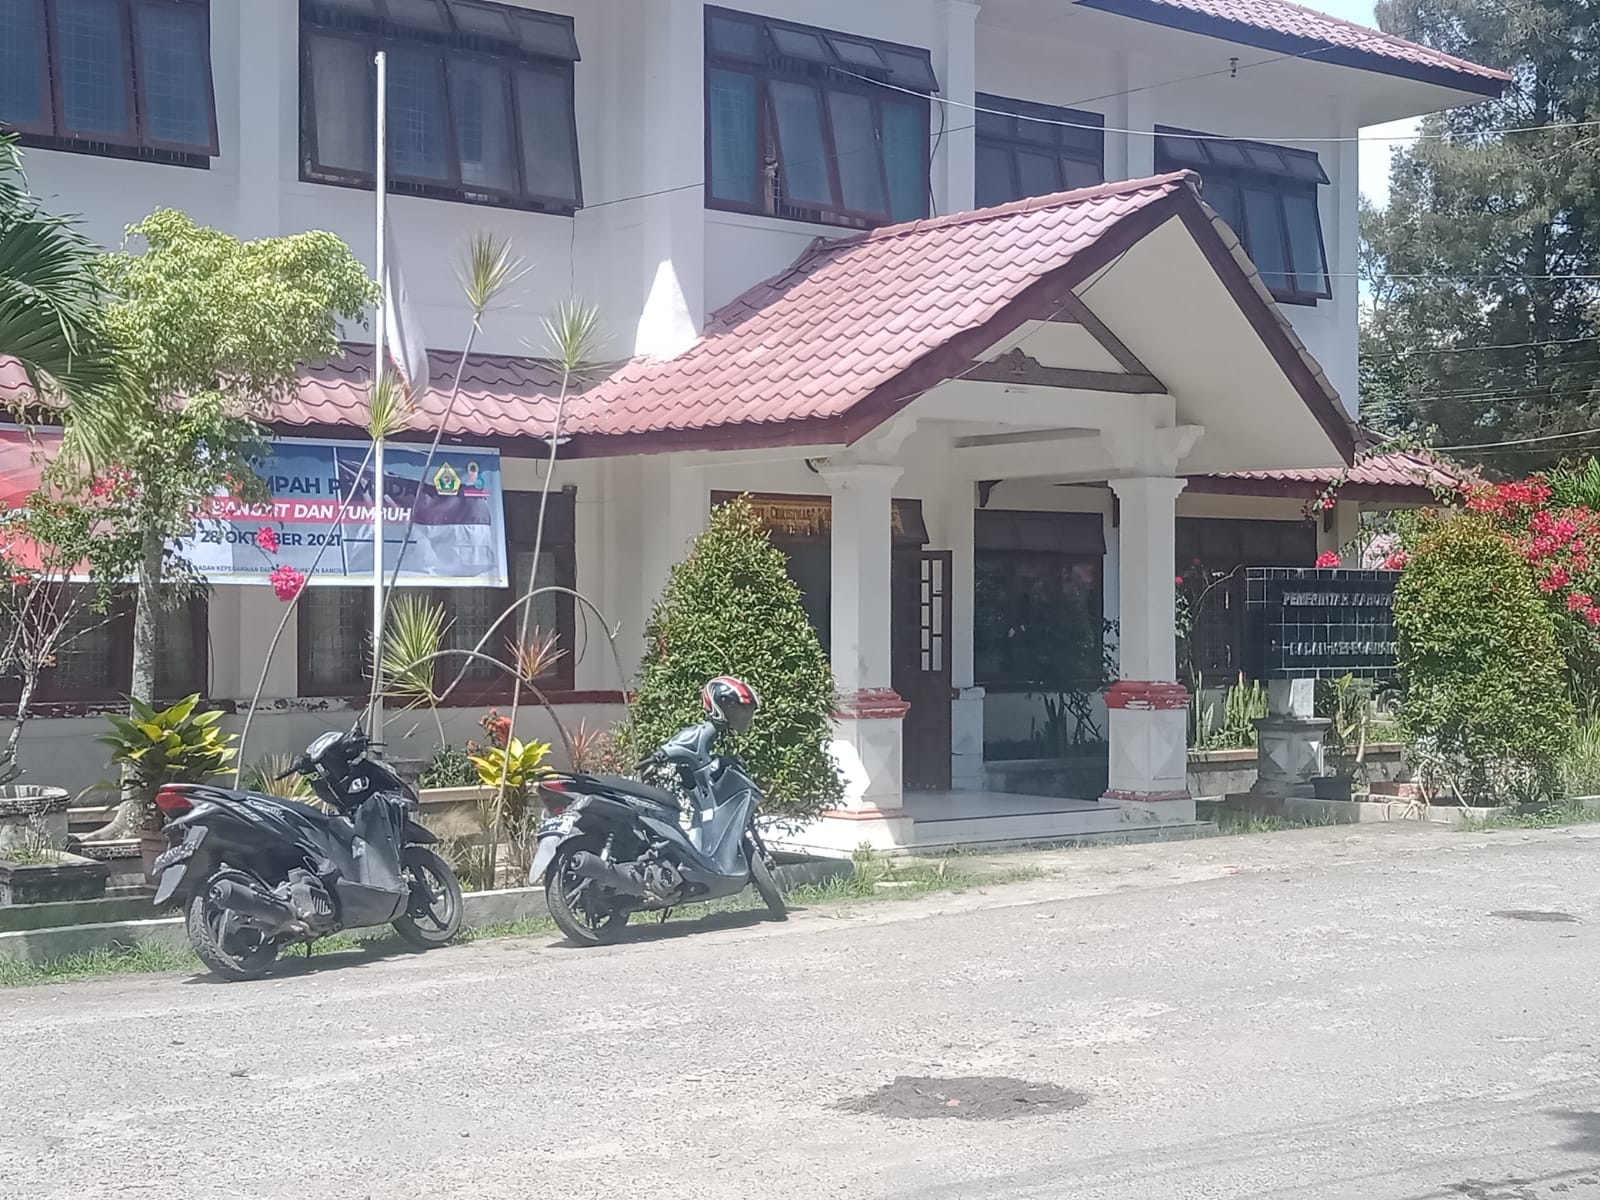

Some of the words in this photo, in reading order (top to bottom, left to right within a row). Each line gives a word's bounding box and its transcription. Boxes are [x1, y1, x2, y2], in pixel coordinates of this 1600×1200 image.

[294, 504, 334, 520] DAN
[339, 505, 412, 523] TUMUH
[225, 531, 303, 547] OKTBER
[307, 533, 341, 547] 2021
